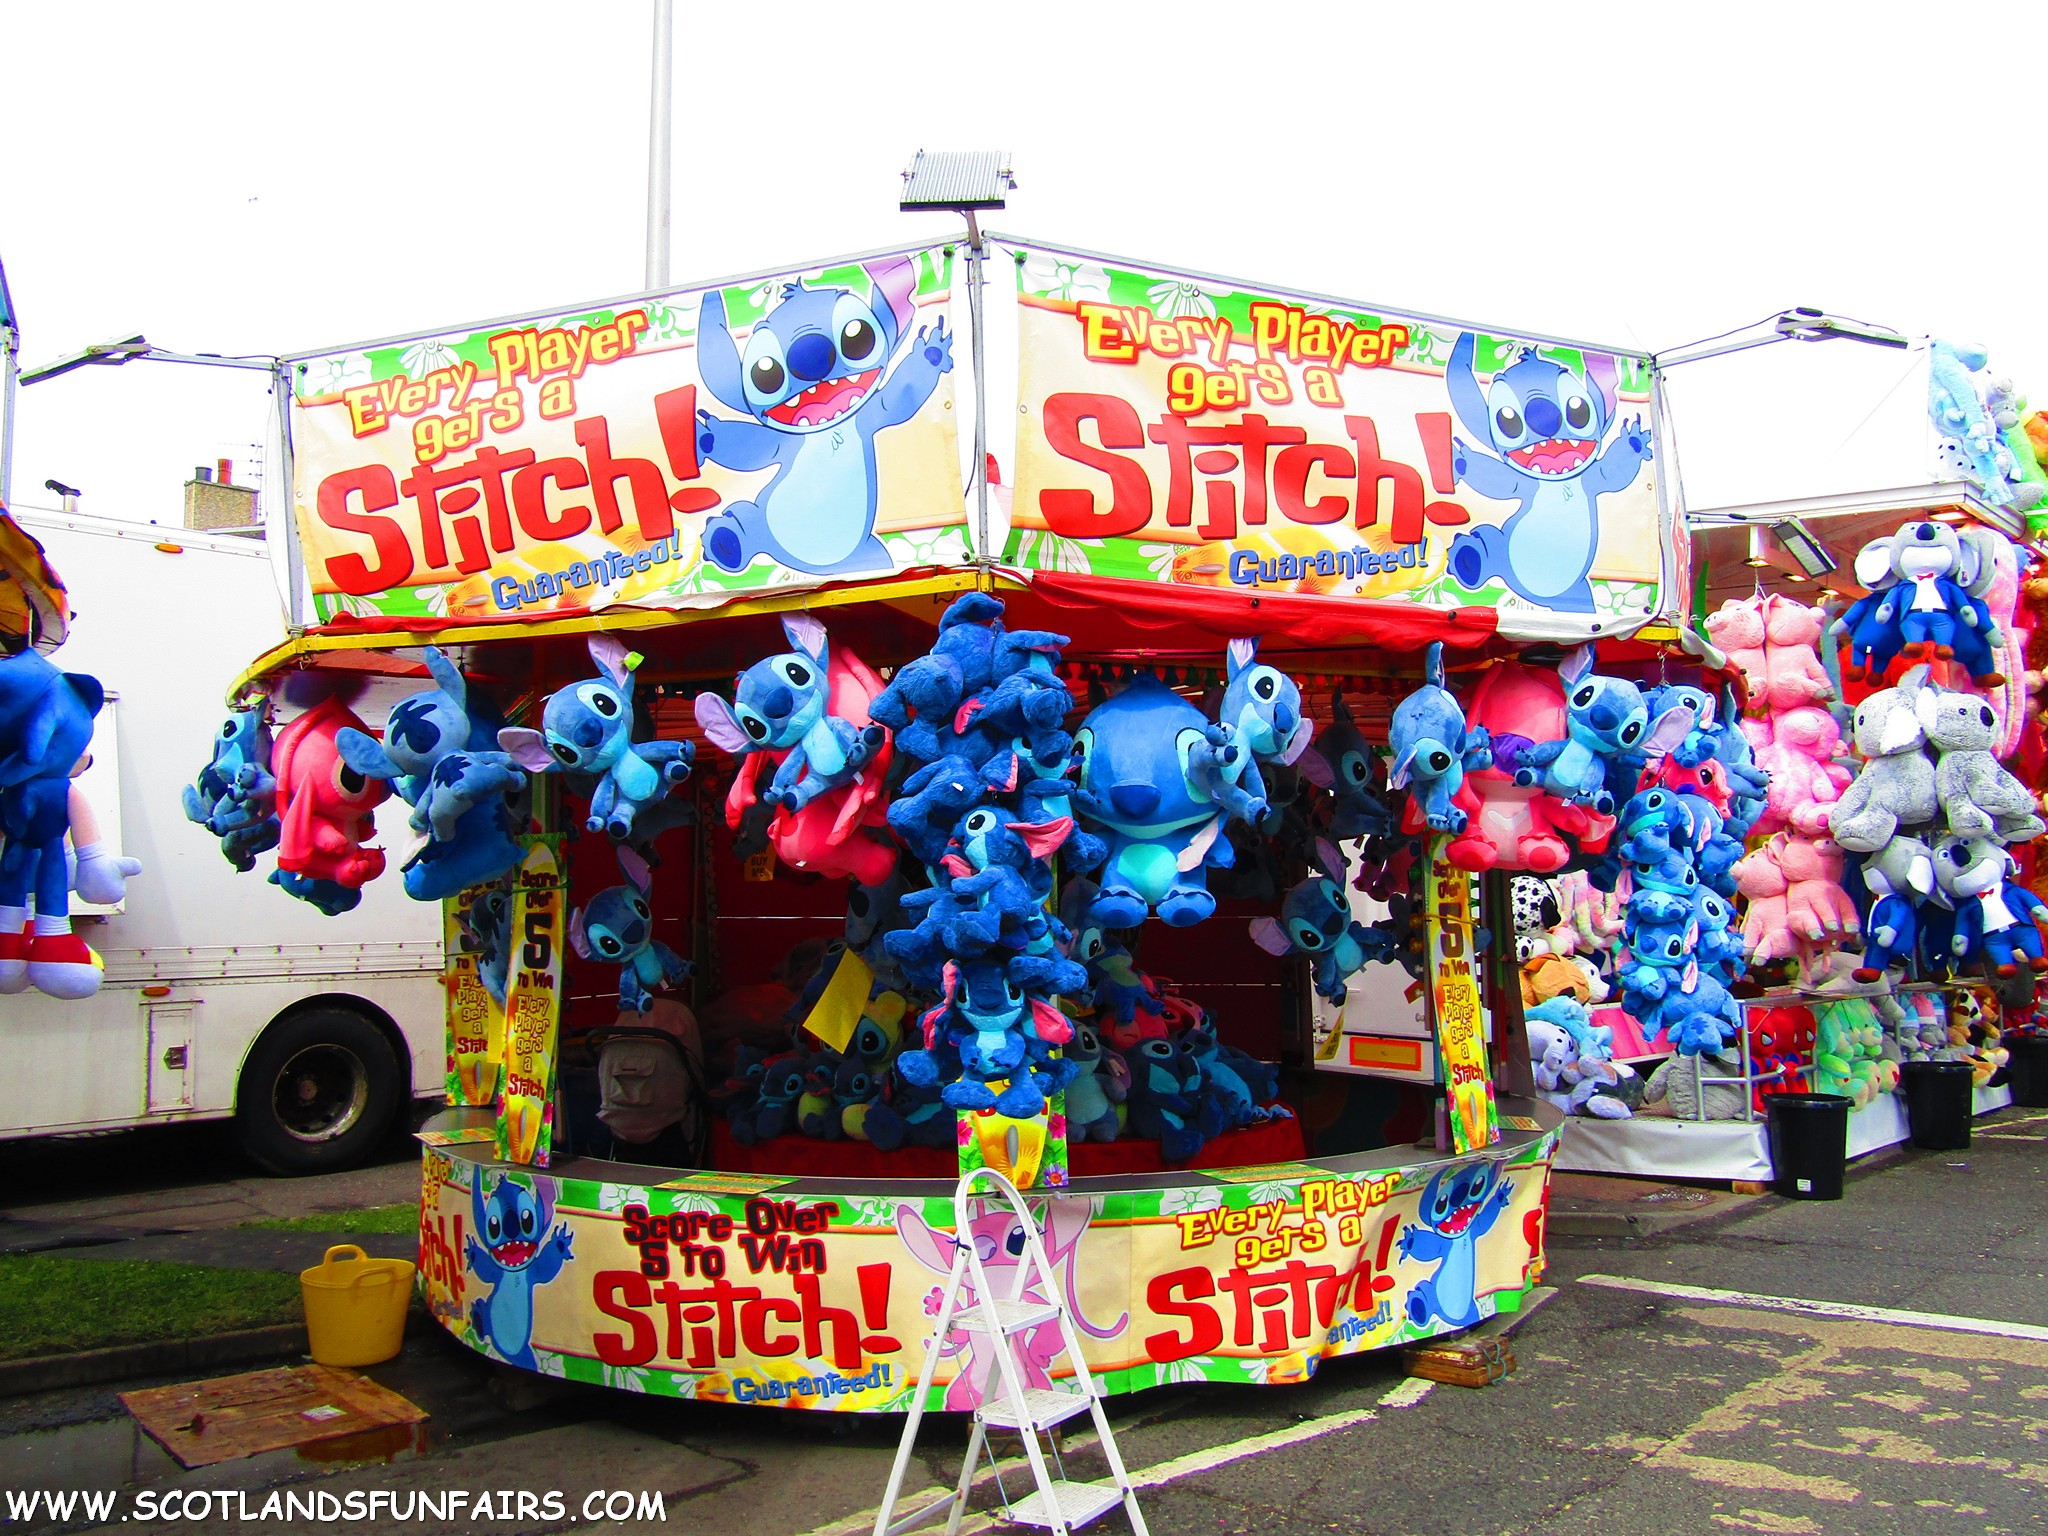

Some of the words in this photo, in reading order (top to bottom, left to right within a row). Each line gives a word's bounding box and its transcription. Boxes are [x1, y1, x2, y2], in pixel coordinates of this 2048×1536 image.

[1077, 301, 1231, 362] Every
[1250, 302, 1410, 370] Player
[343, 361, 479, 439] Every
[489, 309, 649, 388] Player
[1167, 362, 1289, 417] gets
[1304, 367, 1344, 408] a
[412, 386, 527, 466] gets
[538, 377, 577, 419] a
[1038, 392, 1471, 544] Stitch!
[316, 384, 722, 596] Stitch!
[489, 527, 683, 613] Guaranteed!
[1229, 536, 1429, 587] Guaranteed!
[752, 856, 768, 866] BUY
[456, 988, 488, 1006] Playe
[458, 974, 483, 991] Eve
[1443, 983, 1470, 1003] Every
[514, 1011, 550, 1034] Player
[517, 994, 551, 1017] Every
[1443, 1001, 1475, 1023] Player
[516, 1035, 544, 1055] gets
[1450, 1020, 1474, 1045] gets
[1461, 1042, 1470, 1060] a
[523, 1055, 533, 1073] a
[1452, 1061, 1485, 1086] Stitch
[508, 1072, 546, 1100] Stitch
[623, 1202, 733, 1245] Score
[745, 1197, 839, 1239] Over
[1178, 1198, 1287, 1250] Every
[1300, 1172, 1402, 1222] Player
[683, 1238, 725, 1279] to
[738, 1235, 827, 1276] Win
[1235, 1220, 1327, 1268] gets
[1338, 1214, 1363, 1248] a
[593, 1262, 902, 1369] Stitch!
[731, 1362, 892, 1403] Guaranteed!
